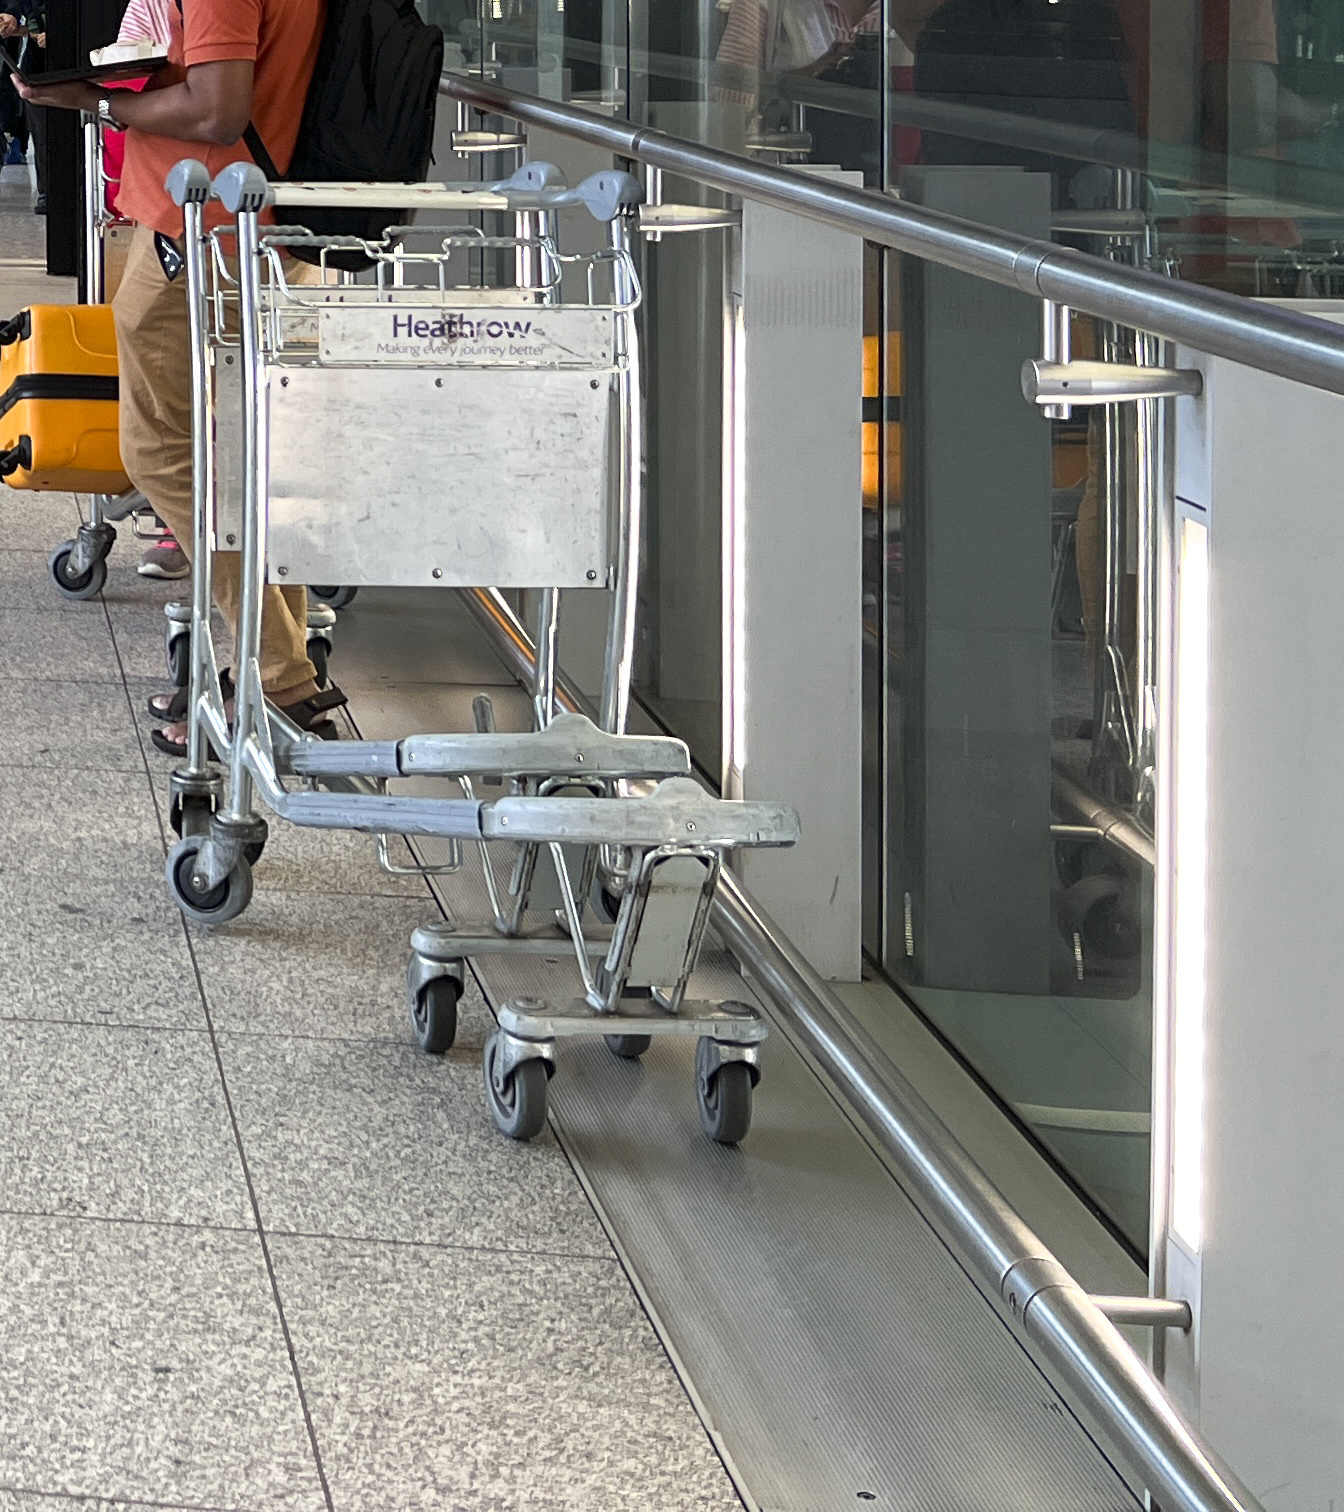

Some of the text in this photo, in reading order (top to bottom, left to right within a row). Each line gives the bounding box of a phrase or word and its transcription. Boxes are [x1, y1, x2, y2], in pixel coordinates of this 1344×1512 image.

[393, 313, 532, 339] Heathrow
[376, 343, 546, 357] Making every journey better
